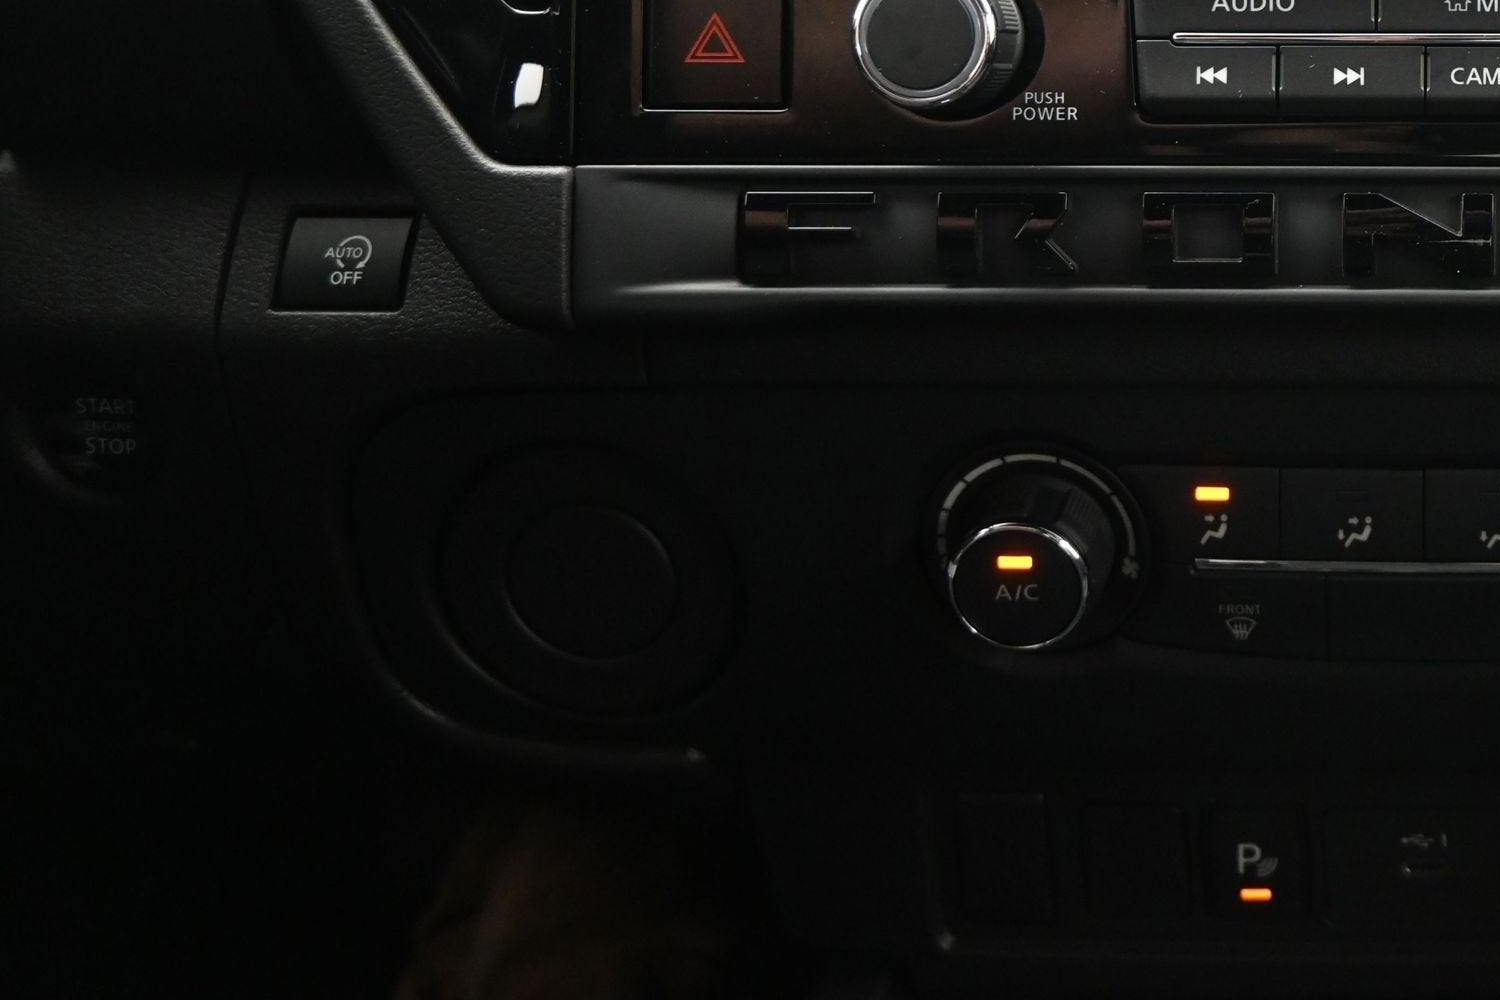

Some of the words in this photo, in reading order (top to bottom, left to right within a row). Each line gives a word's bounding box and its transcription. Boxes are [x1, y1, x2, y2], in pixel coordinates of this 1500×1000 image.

[1024, 92, 1065, 105] PUSH
[1012, 106, 1078, 121] POWER
[324, 247, 364, 259] AUTO
[330, 271, 364, 285] OFF
[75, 397, 137, 416] START
[84, 436, 137, 456] STOP
[995, 584, 1040, 602] A/C
[1218, 604, 1261, 616] FRONT
[1237, 843, 1262, 876] P
